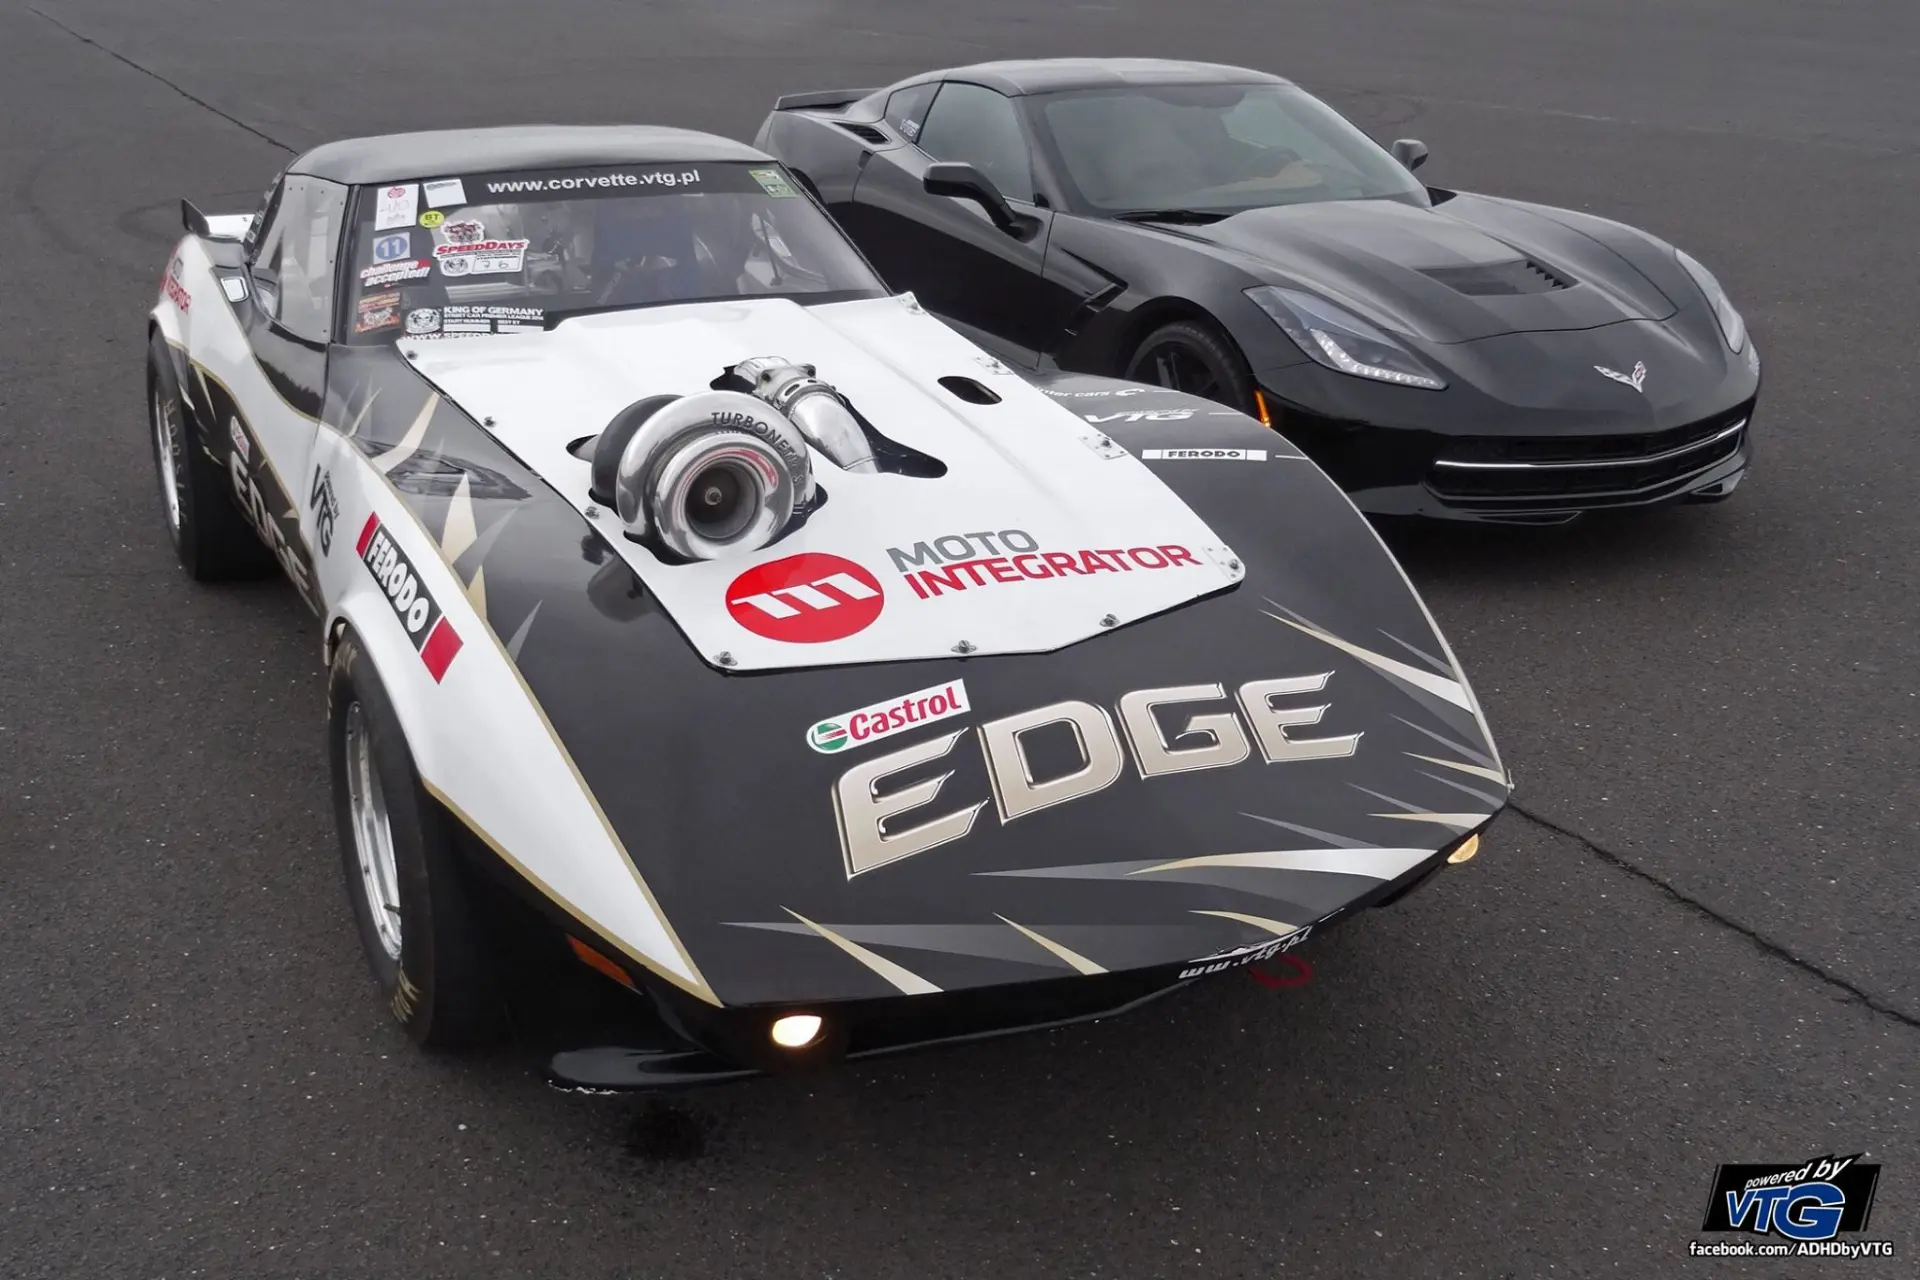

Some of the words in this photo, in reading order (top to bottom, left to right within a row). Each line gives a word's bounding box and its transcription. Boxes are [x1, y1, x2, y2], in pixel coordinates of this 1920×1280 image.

[487, 170, 700, 194] www.corvette.vtg.pl
[381, 239, 401, 258] 11
[443, 306, 470, 314] KING
[471, 306, 487, 314] OF
[488, 307, 544, 316] GERMANY
[1084, 410, 1195, 423] VTG
[1167, 450, 1241, 459] FERODO
[310, 463, 334, 558] VTG
[886, 529, 1040, 573] MOTO
[903, 544, 1203, 600] INTEGRATOR
[366, 530, 430, 634] FERODO
[849, 685, 962, 741] Castrol
[831, 670, 1365, 881] EDGE
